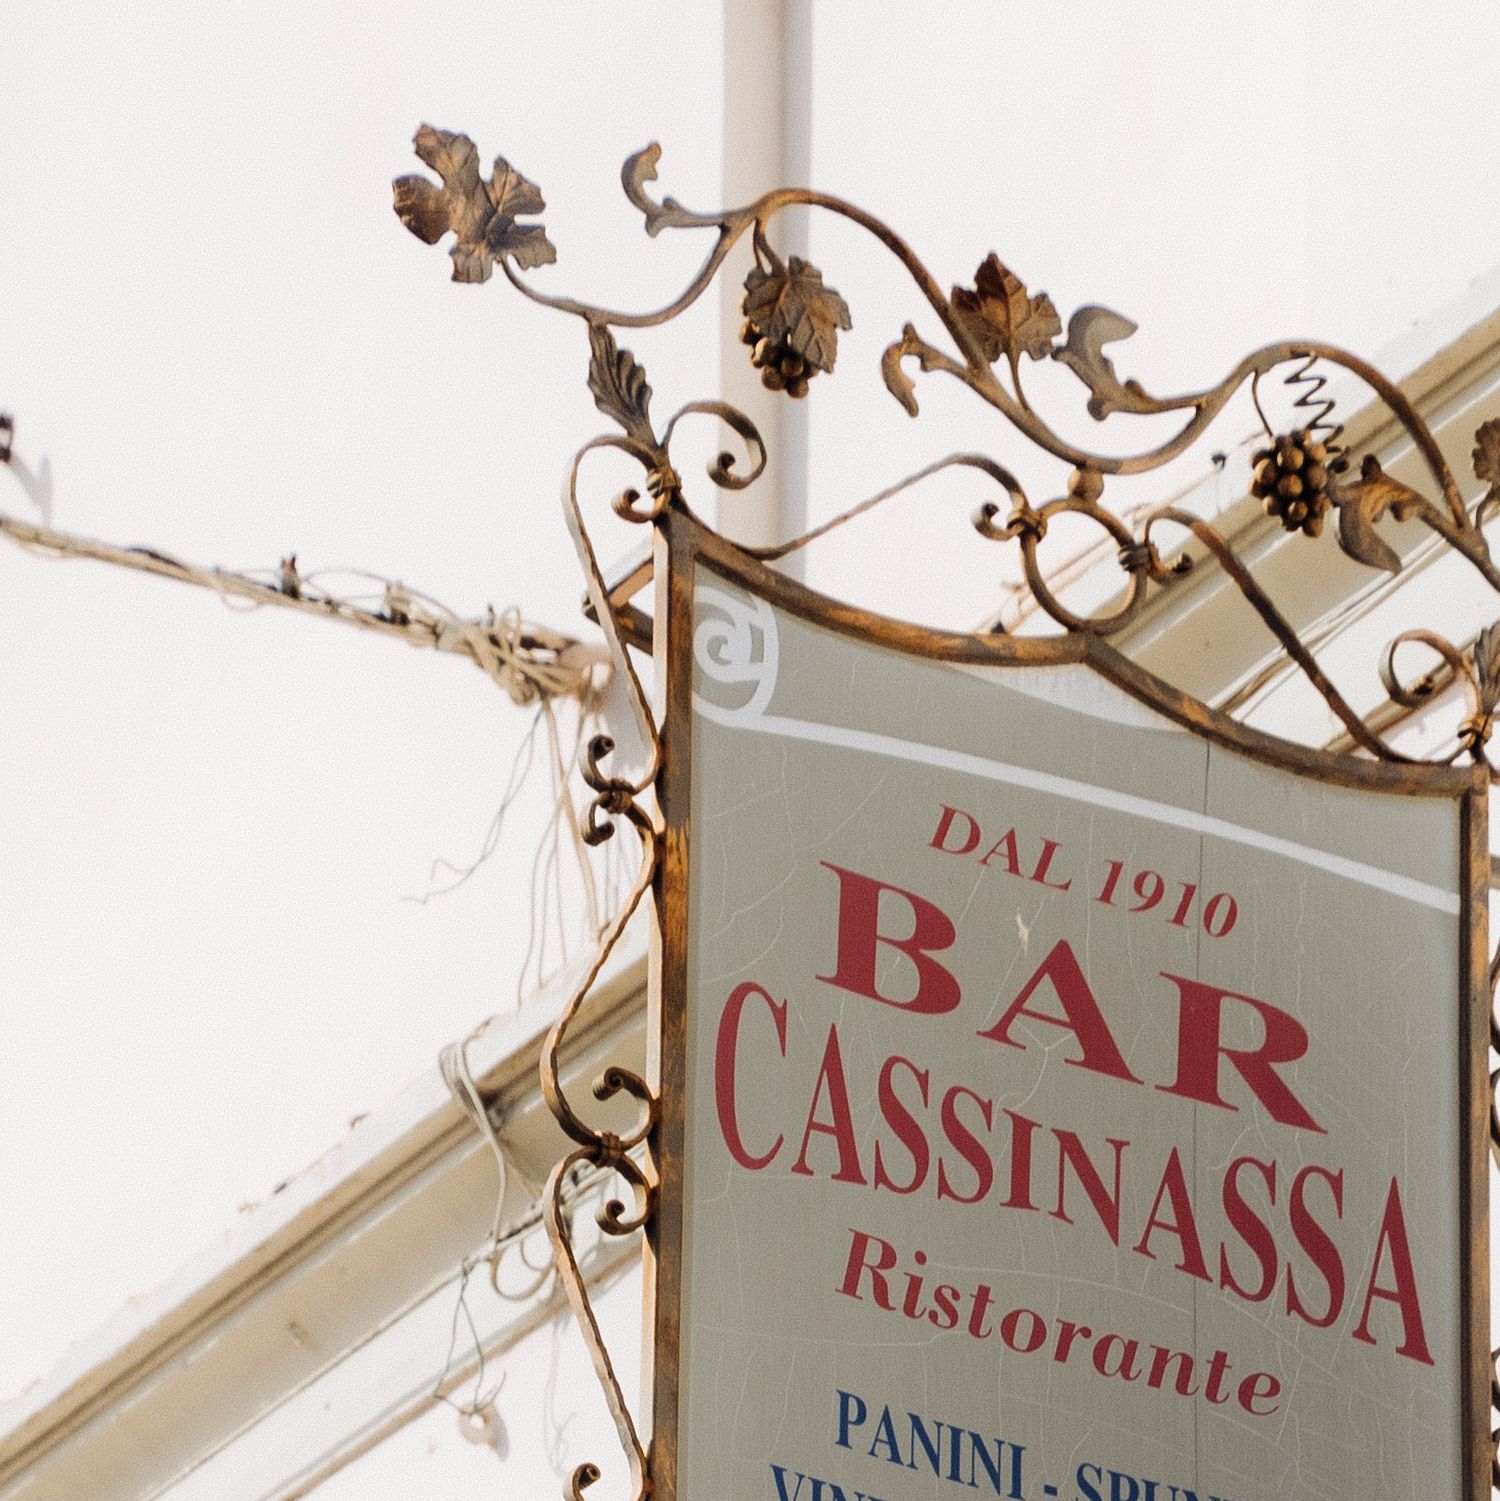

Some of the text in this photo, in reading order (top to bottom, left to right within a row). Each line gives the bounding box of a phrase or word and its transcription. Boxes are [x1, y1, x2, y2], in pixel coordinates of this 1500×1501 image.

[928, 804, 1240, 938] DAL 1910
[815, 860, 1328, 1134] BAR
[714, 981, 1436, 1367] CASSINASSA
[834, 1228, 1283, 1417] Ristorante
[836, 1391, 1025, 1501] PANINI
